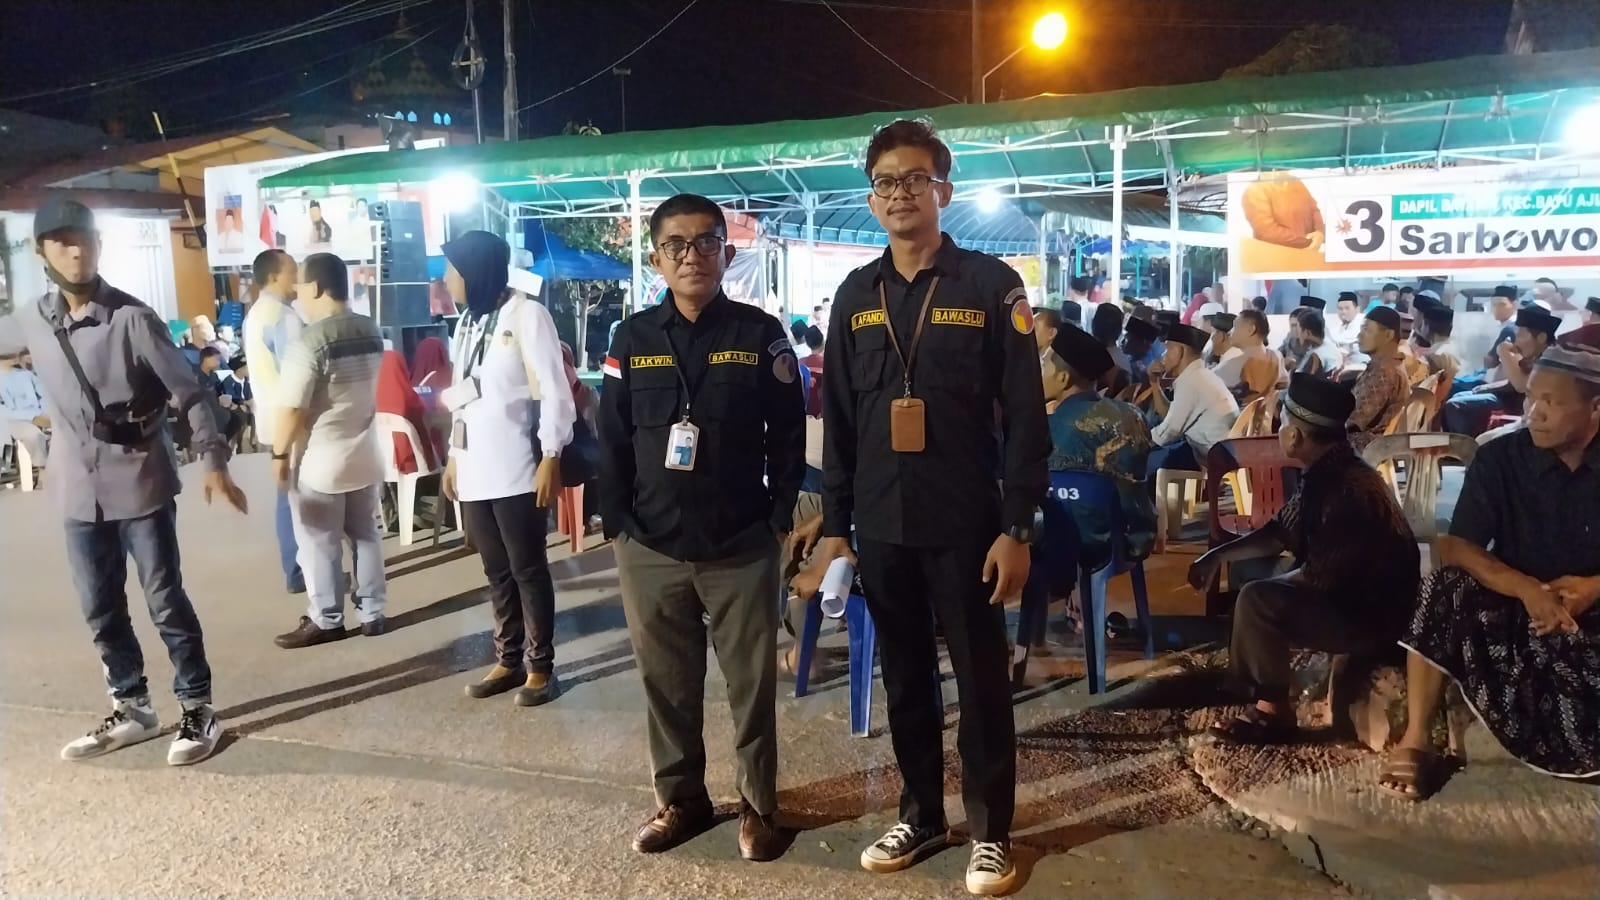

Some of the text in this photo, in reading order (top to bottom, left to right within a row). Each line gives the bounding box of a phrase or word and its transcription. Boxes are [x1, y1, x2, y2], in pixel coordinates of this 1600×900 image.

[1399, 199, 1438, 214] DAPIL
[1344, 200, 1385, 253] 3
[1399, 223, 1598, 256] Sarbowo
[934, 310, 983, 325] BAWASLU
[634, 357, 673, 366] TAKWIN
[711, 352, 755, 363] BAWASLU
[1057, 487, 1080, 500] 03
